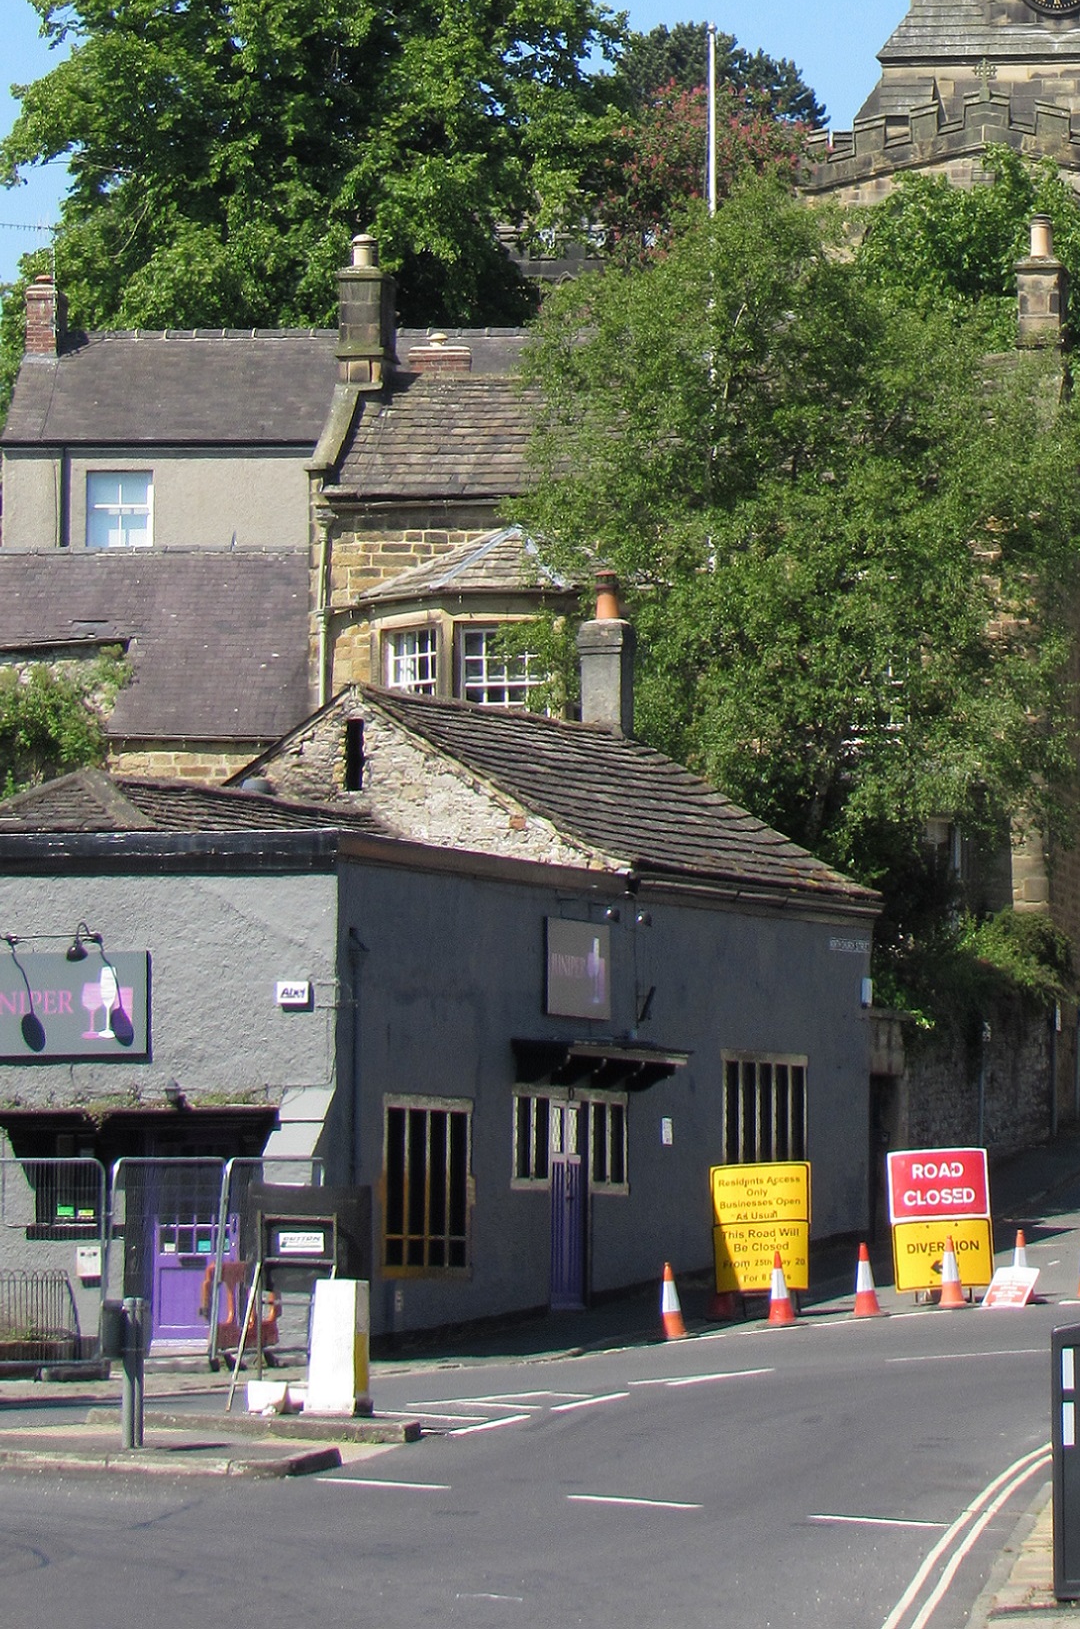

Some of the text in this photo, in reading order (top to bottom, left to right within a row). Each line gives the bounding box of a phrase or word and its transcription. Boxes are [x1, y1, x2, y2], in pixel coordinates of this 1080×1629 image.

[911, 1162, 964, 1179] ROAD
[718, 1176, 800, 1187] Residents Access
[746, 1188, 768, 1197] Only
[903, 1187, 976, 1206] CLOSED
[719, 1197, 801, 1209] Businesses Open
[736, 1210, 778, 1220] As Usual
[722, 1228, 800, 1239] This Road Will
[733, 1242, 789, 1252] Be Closed
[906, 1240, 980, 1254] DIVERION
[722, 1259, 750, 1268] From
